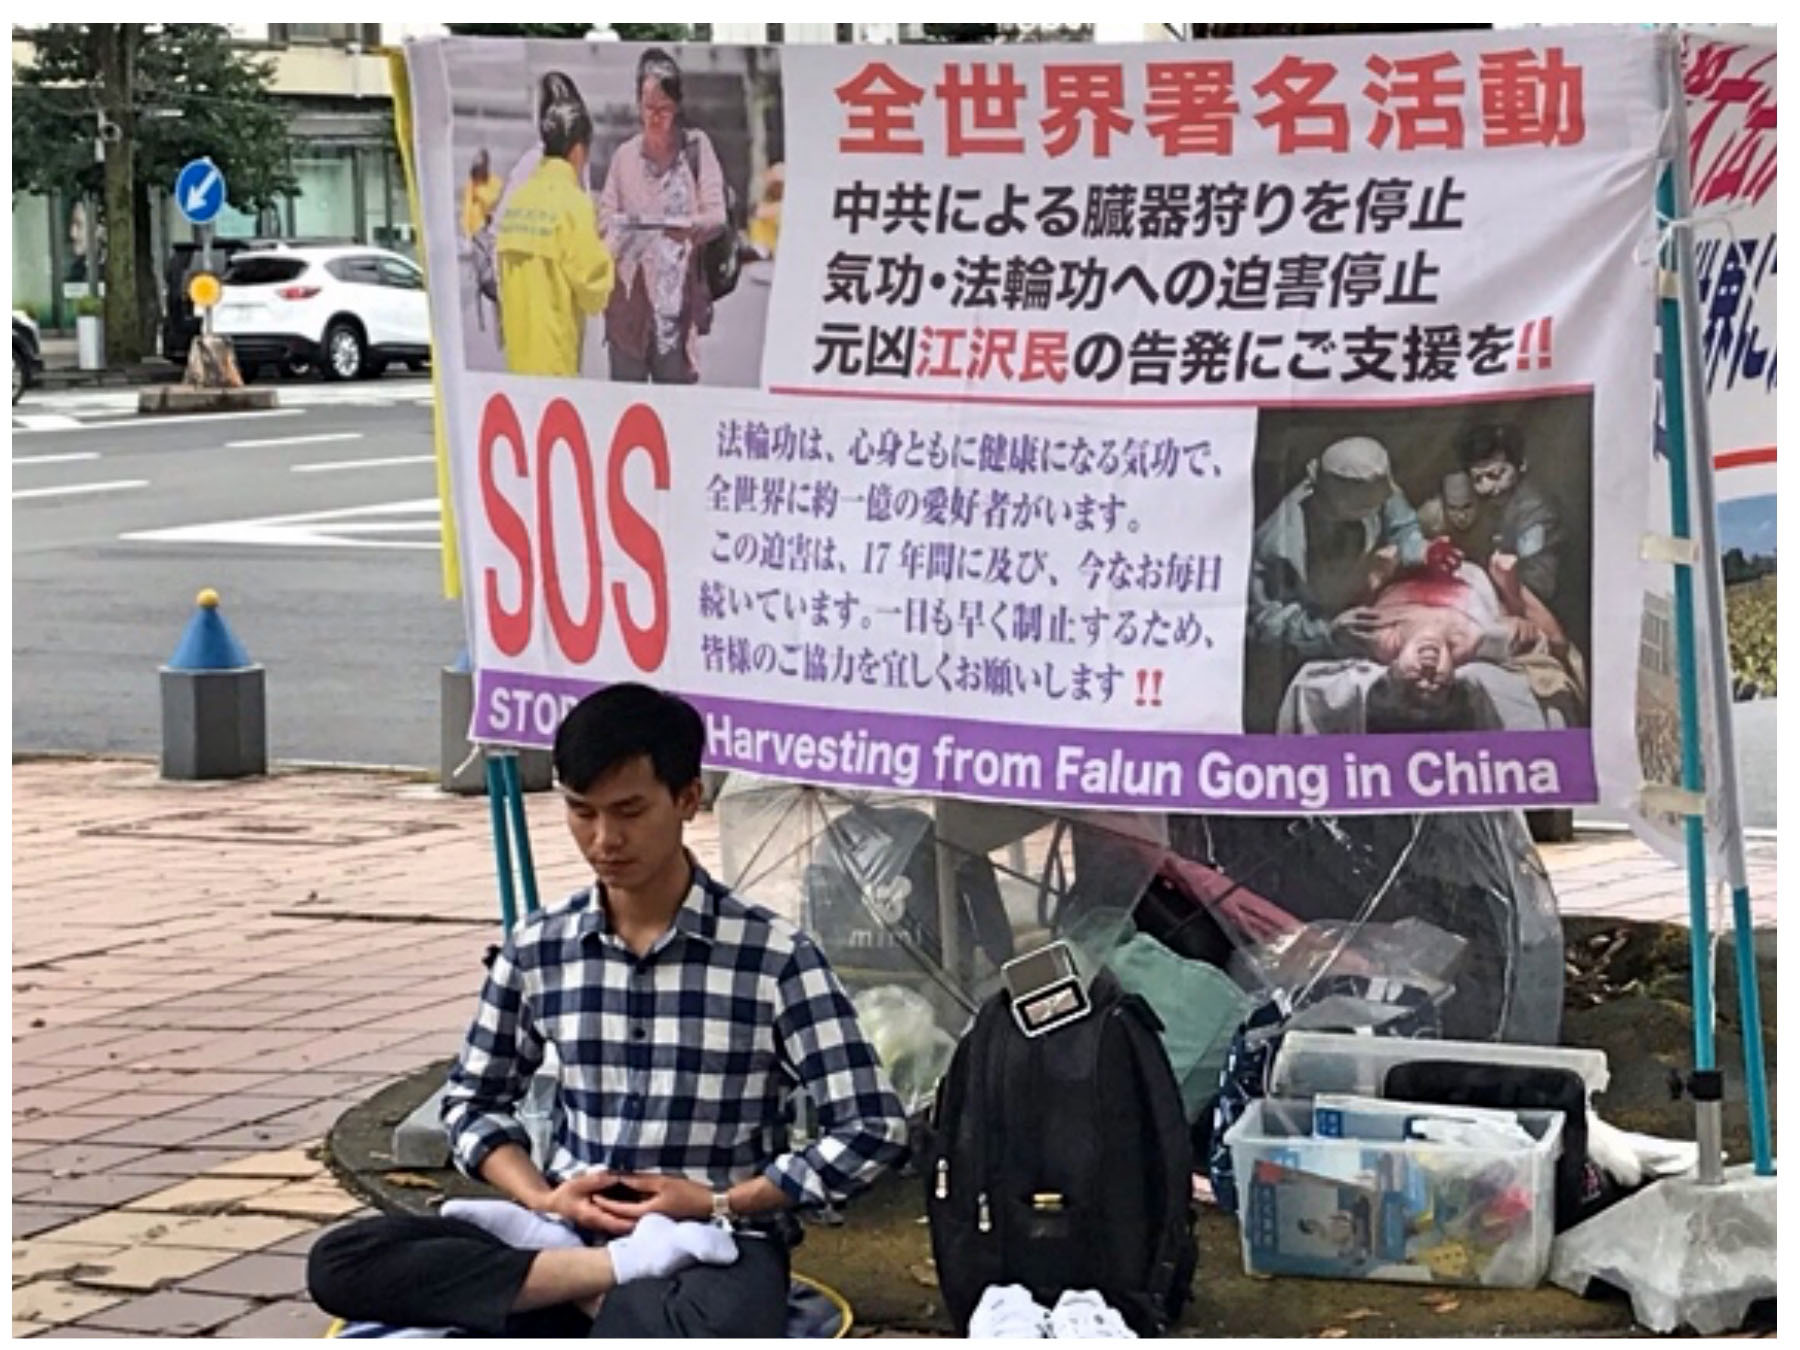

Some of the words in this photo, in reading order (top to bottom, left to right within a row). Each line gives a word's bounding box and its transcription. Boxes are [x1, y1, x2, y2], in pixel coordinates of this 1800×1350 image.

[833, 48, 1586, 158] 全世界署名活動
[832, 177, 1466, 240] 中共による臓器狩りを停止
[823, 252, 1440, 312] 気功・法輪功への迫害停止
[716, 420, 1223, 478] 法輪功は、心身ともに健康になる気功で、
[479, 393, 671, 673] SOS
[706, 475, 1142, 534] 全世界に約一億の愛好者がいます。
[699, 581, 1216, 650] 続いています。一日も早く制止するため、
[707, 713, 919, 786] Harvesting
[933, 735, 1041, 788] from
[1056, 747, 1181, 797] Falun
[1199, 751, 1329, 806] Gong
[1345, 754, 1392, 797] in
[1408, 750, 1561, 796] China
